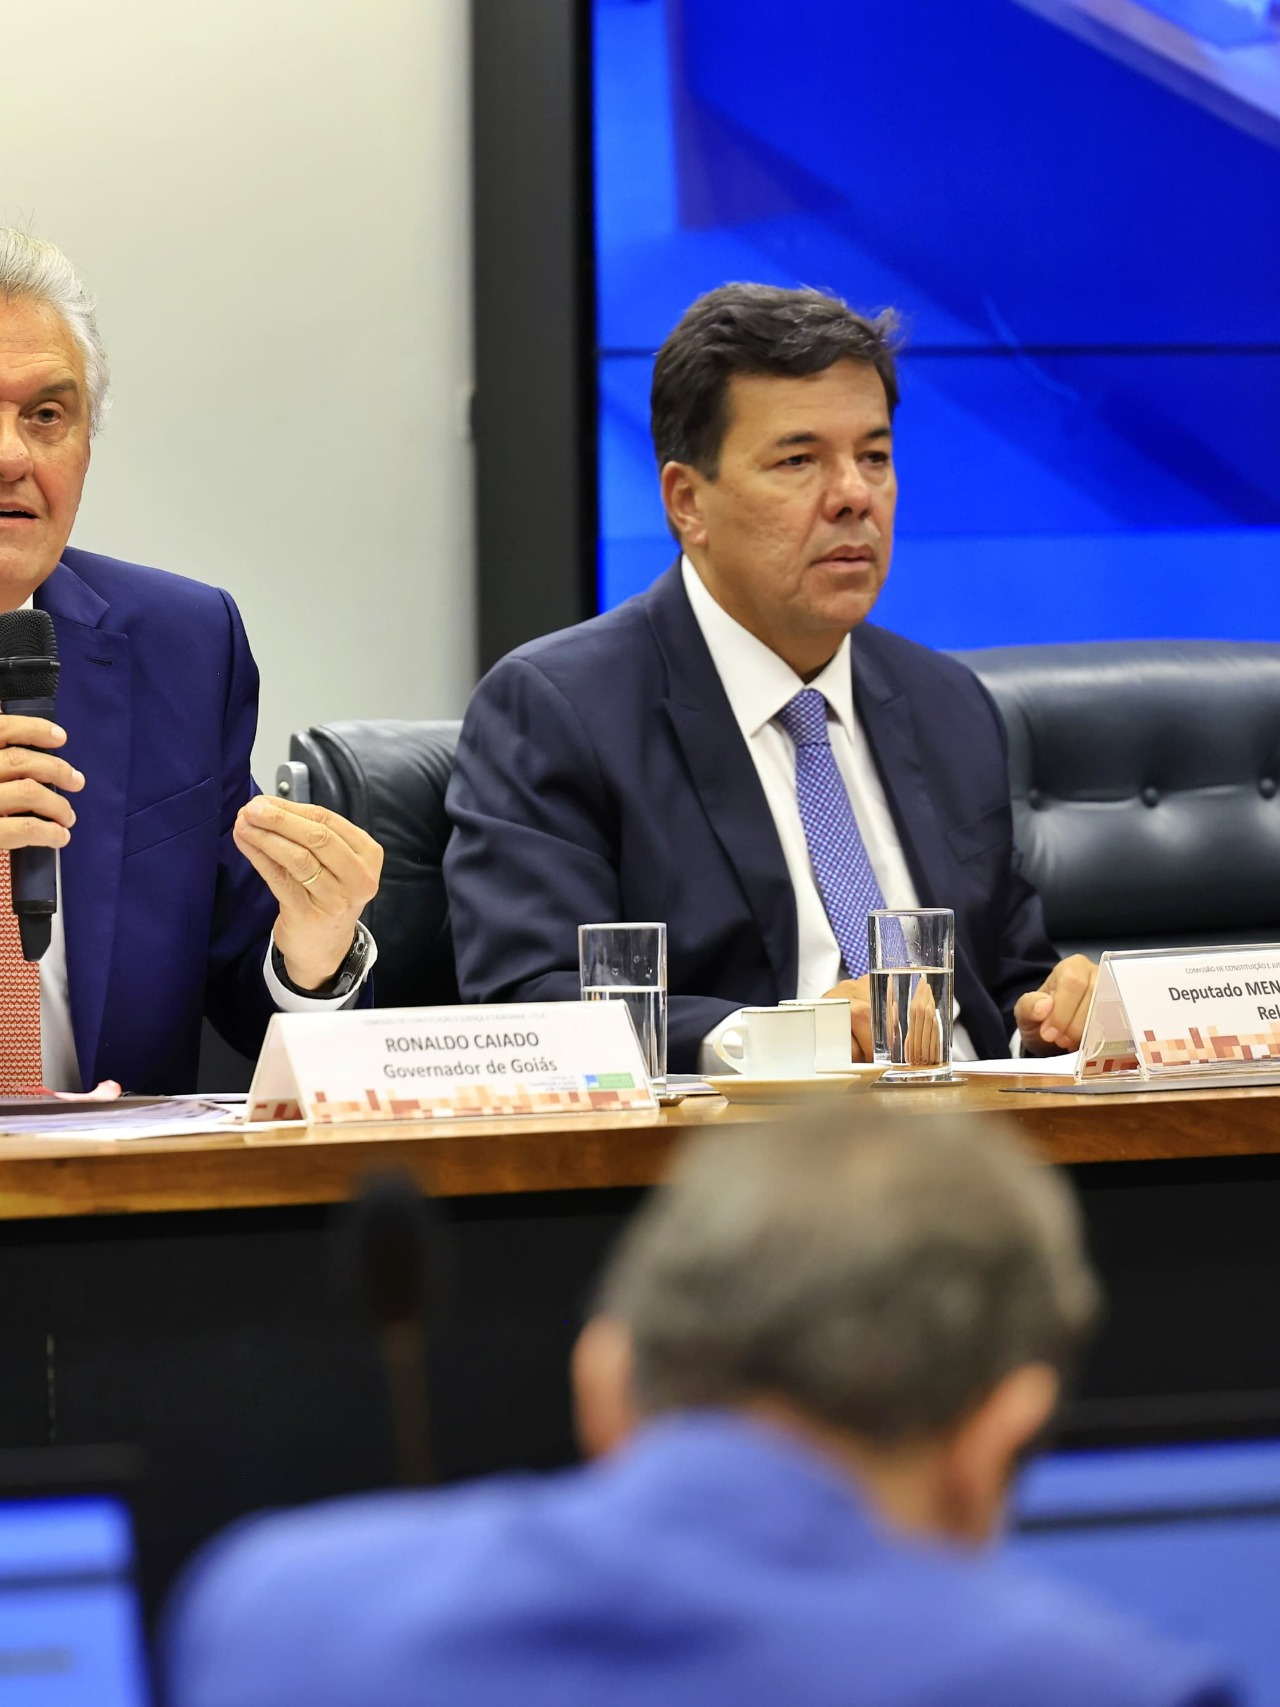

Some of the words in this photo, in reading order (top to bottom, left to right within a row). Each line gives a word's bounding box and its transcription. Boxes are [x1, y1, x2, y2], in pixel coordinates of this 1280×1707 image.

[1225, 962, 1266, 972] CONSTITUIÇÃO
[1169, 983, 1243, 1003] Deputado
[1245, 980, 1280, 996] MEN
[1257, 1004, 1280, 1020] Rel
[385, 1035, 469, 1053] RONALDO
[474, 1031, 540, 1049] CAIADO
[383, 1061, 481, 1079] Governador
[486, 1061, 506, 1075] de
[511, 1057, 558, 1074] Goiás
